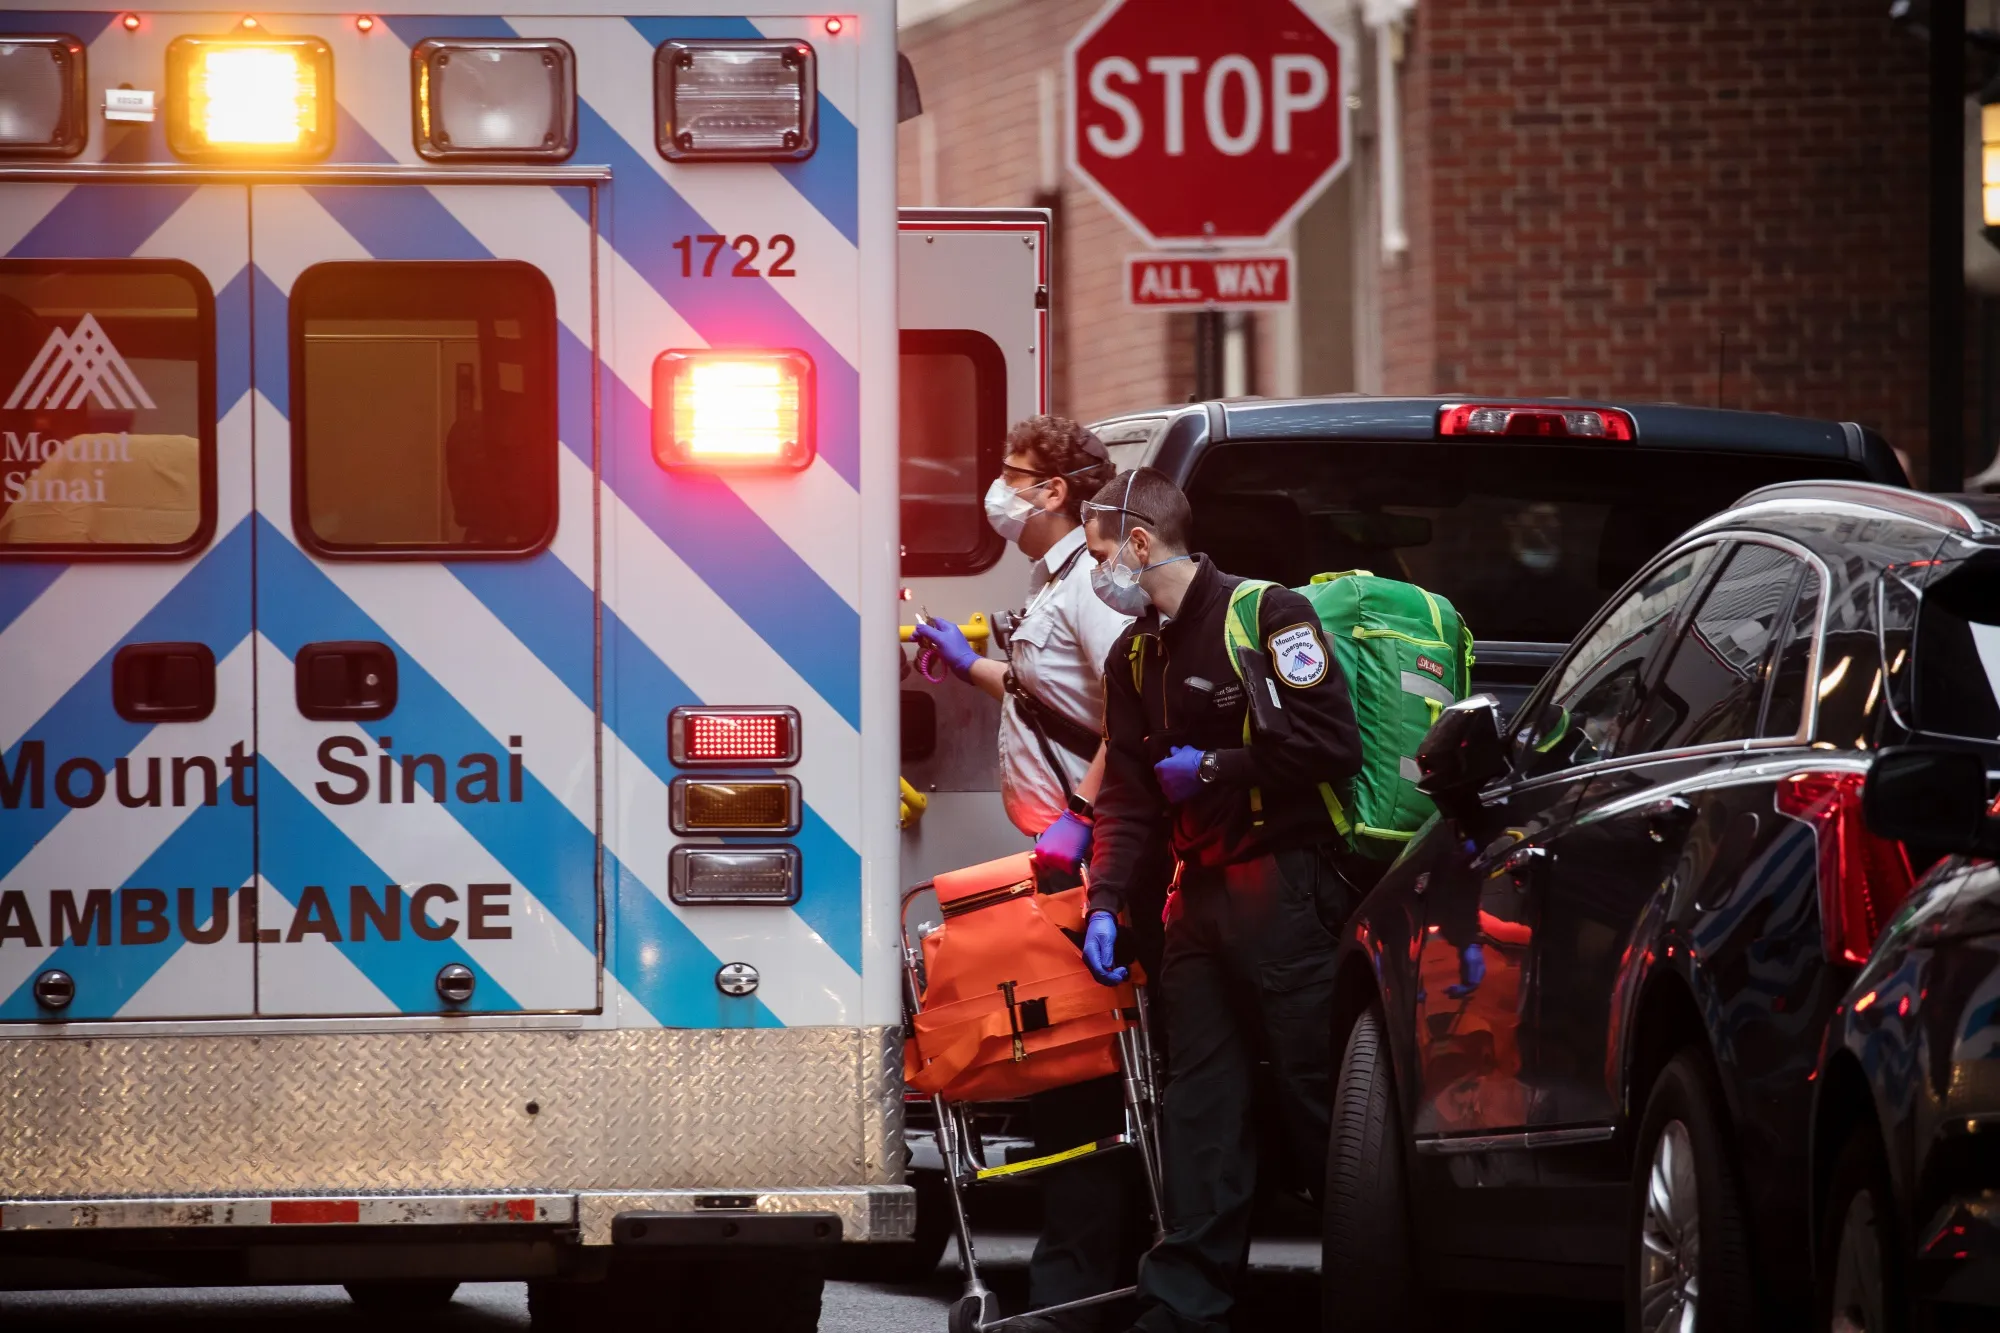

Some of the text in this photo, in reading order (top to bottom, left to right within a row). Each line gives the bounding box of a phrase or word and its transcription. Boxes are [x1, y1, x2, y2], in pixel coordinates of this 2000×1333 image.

[1086, 54, 1329, 159] STOP
[672, 234, 796, 277] 1722
[1139, 262, 1280, 299] ALL WAY
[2, 431, 133, 462] Mount
[4, 468, 107, 503] Sinai
[1275, 629, 1311, 647] Mount Sinai
[1282, 641, 1314, 658] Emergency
[1287, 661, 1323, 682] Medical Services
[0, 735, 524, 809] Mount Sinai
[0, 883, 514, 948] AMBULANCE
